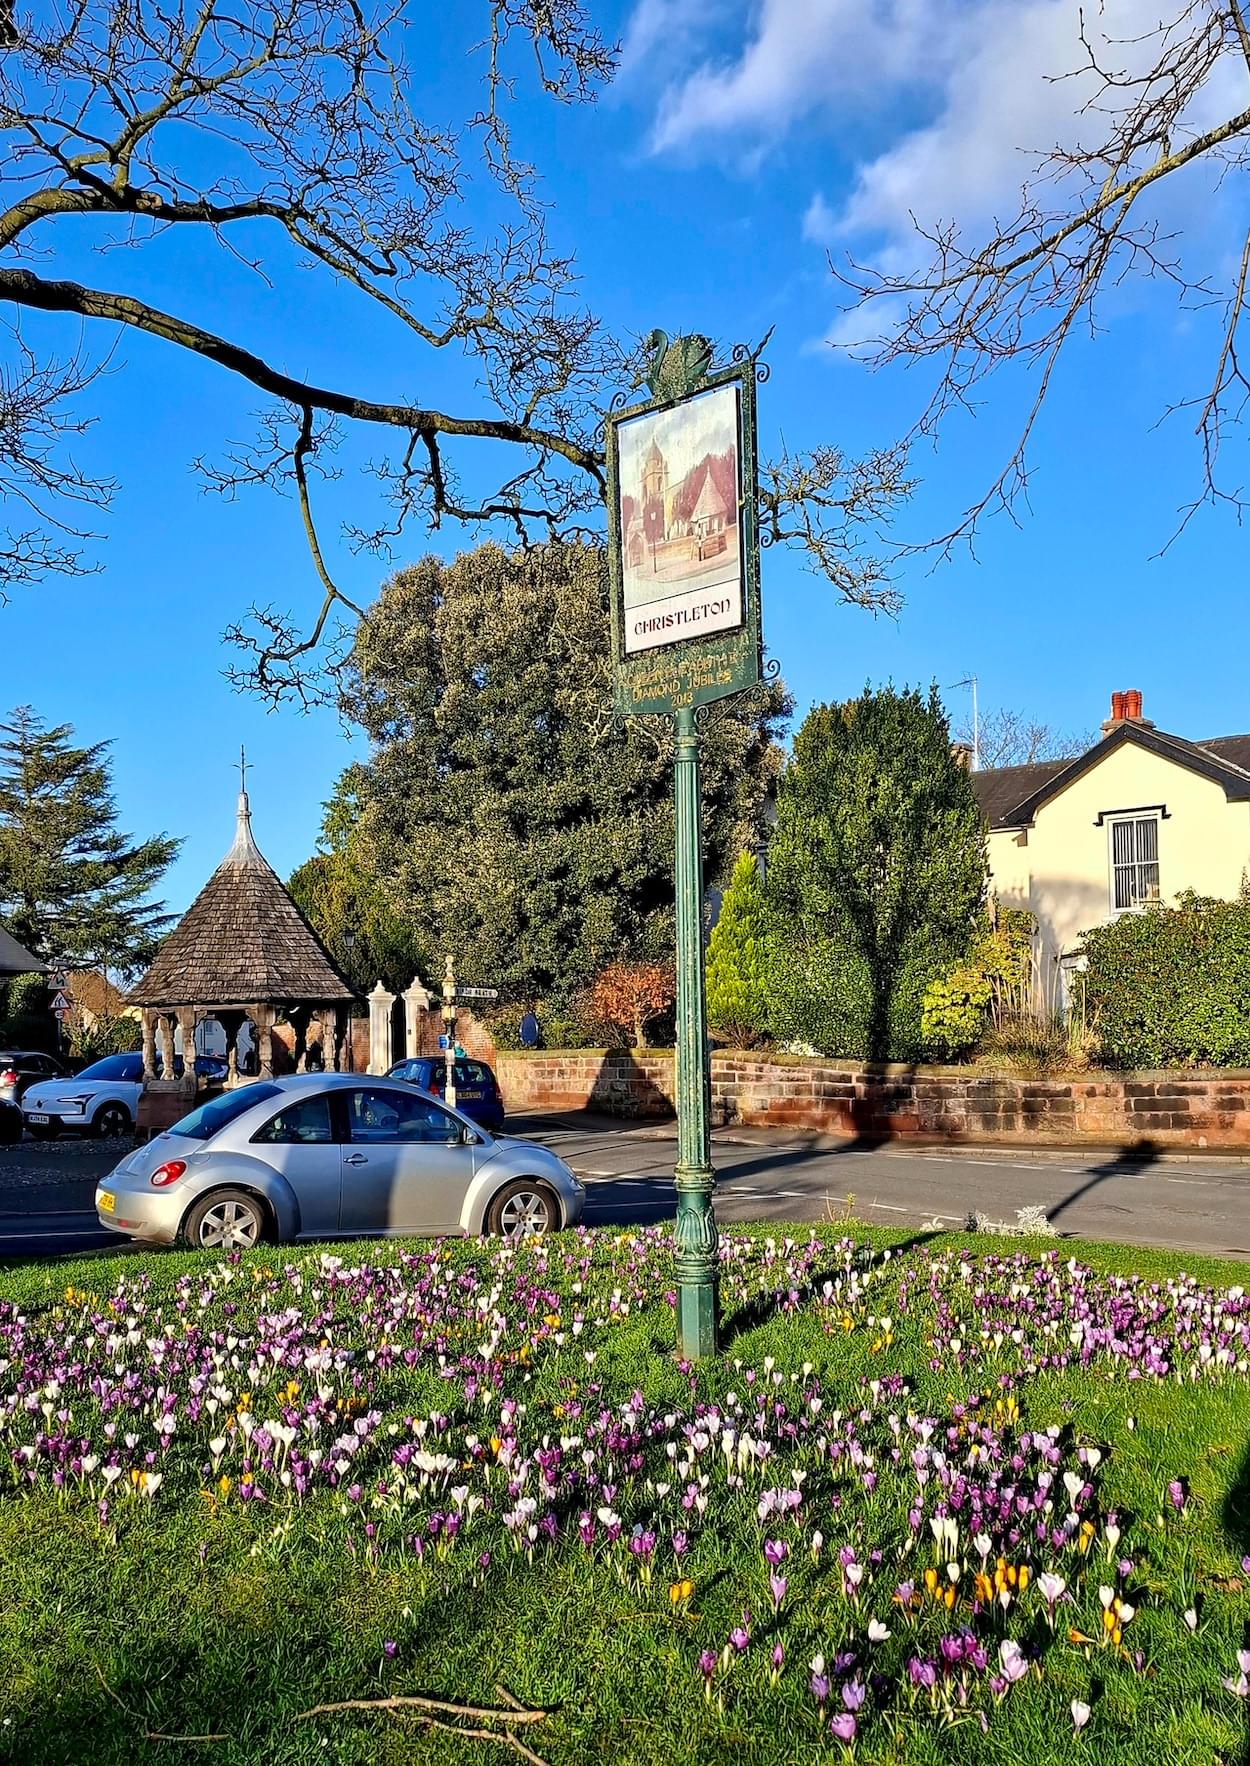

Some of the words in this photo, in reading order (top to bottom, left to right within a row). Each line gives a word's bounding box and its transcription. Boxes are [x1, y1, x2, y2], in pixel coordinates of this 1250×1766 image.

[634, 598, 731, 636] CHRISTLETON
[632, 679, 680, 703] DIAMOND
[687, 669, 732, 690] JUBILEE
